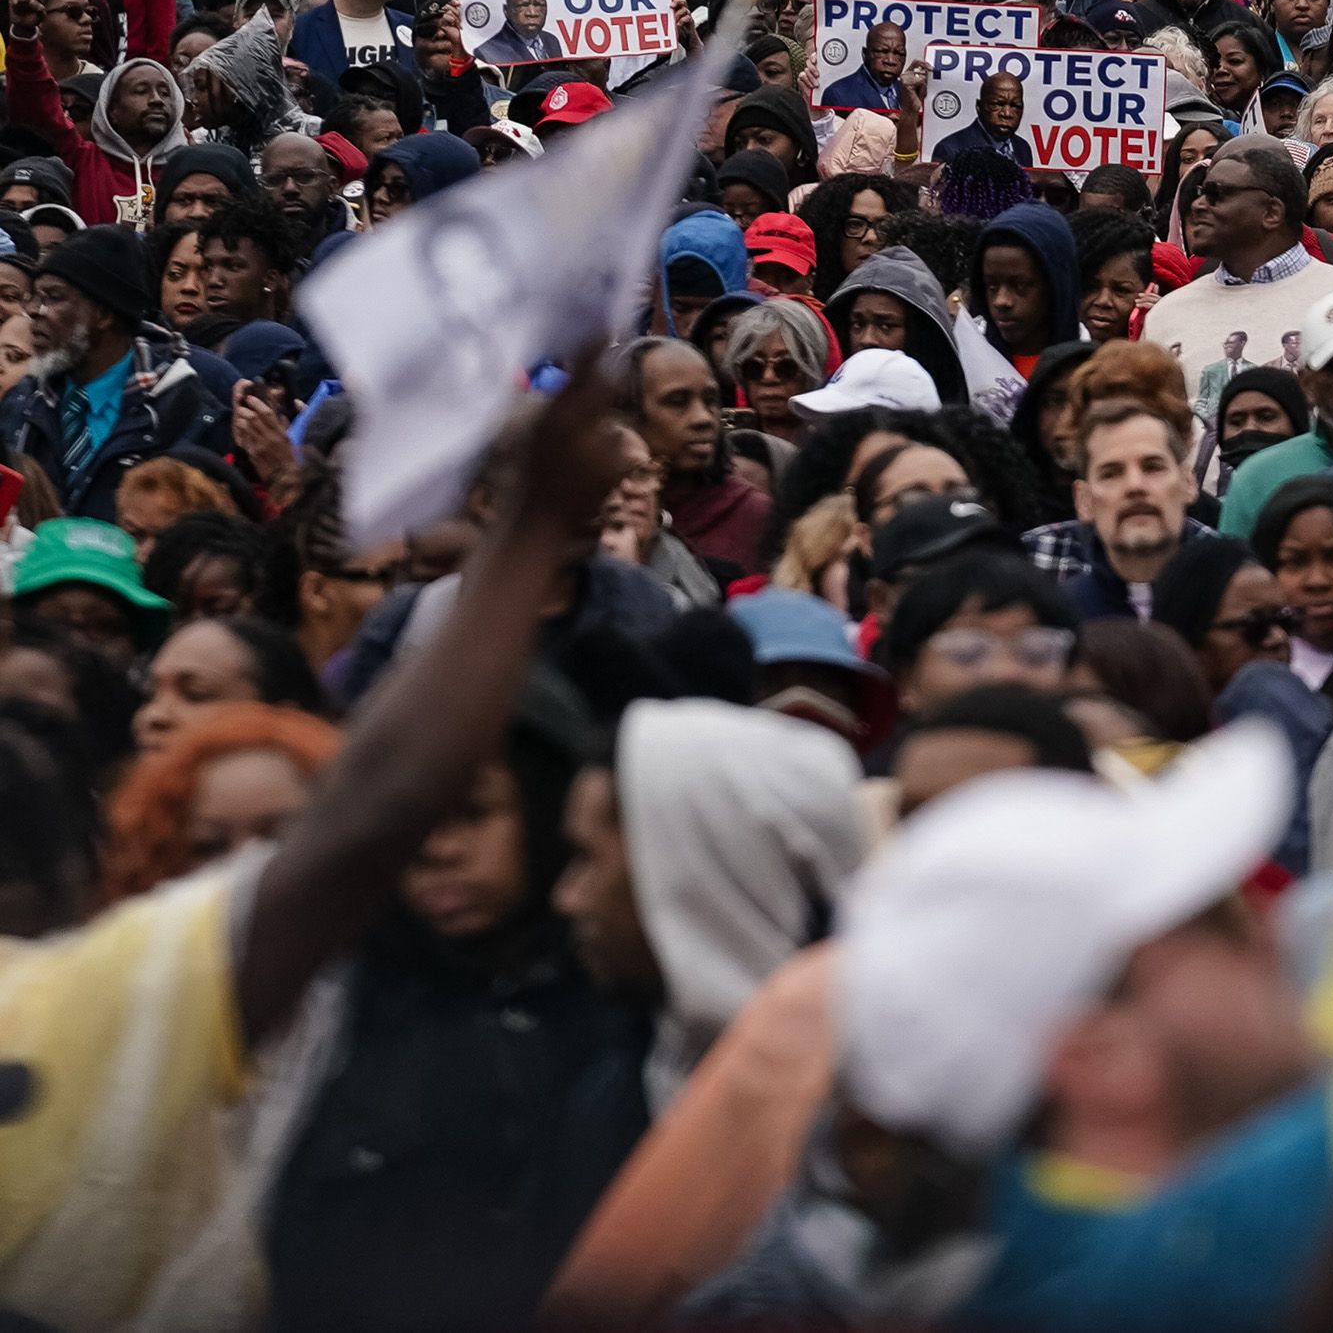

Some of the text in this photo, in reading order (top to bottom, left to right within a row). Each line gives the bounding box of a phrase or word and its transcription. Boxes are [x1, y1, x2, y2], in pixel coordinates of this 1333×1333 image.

[556, 12, 673, 57] VOTE!
[933, 48, 1160, 90] PROTECT
[1043, 90, 1146, 125] OUR
[1031, 123, 1157, 170] VOTE!
